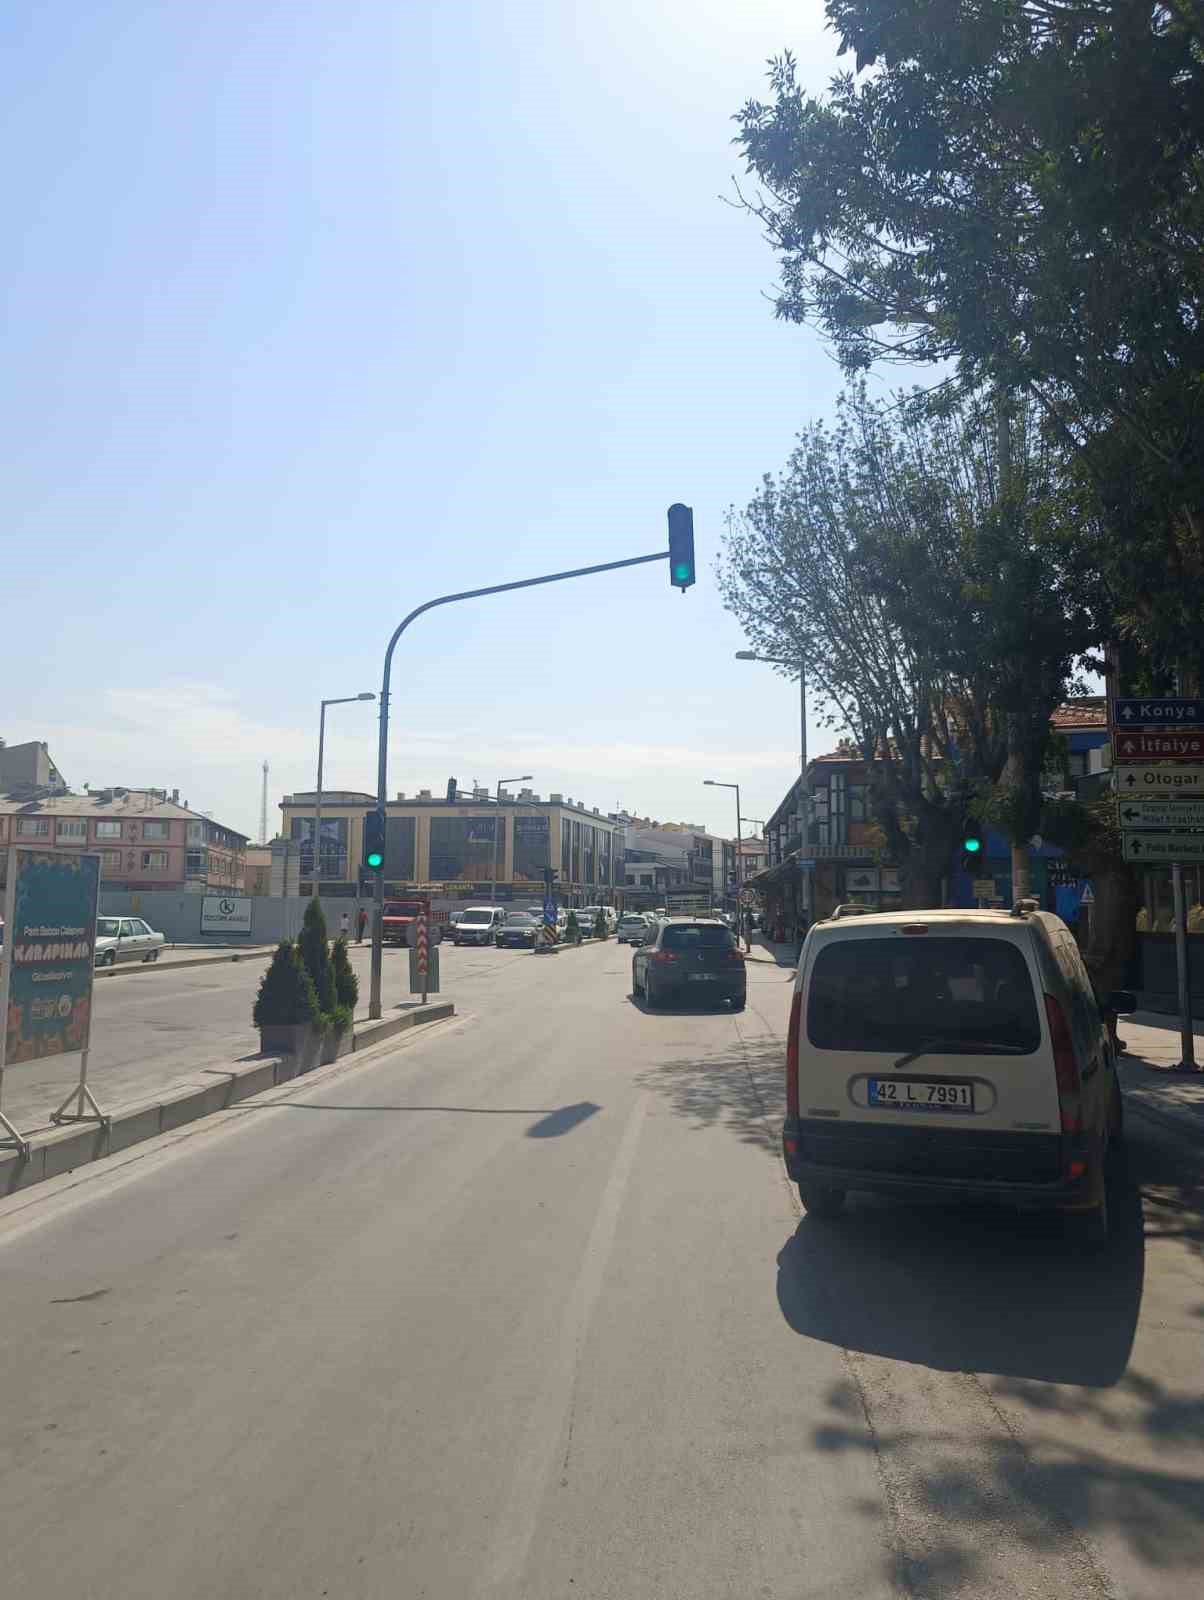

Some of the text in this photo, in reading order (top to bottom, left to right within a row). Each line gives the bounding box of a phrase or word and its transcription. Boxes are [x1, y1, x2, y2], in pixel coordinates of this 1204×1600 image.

[1140, 704, 1195, 719] Konya
[1143, 772, 1199, 787] Otogar
[878, 1084, 967, 1104] 42 L 7991
